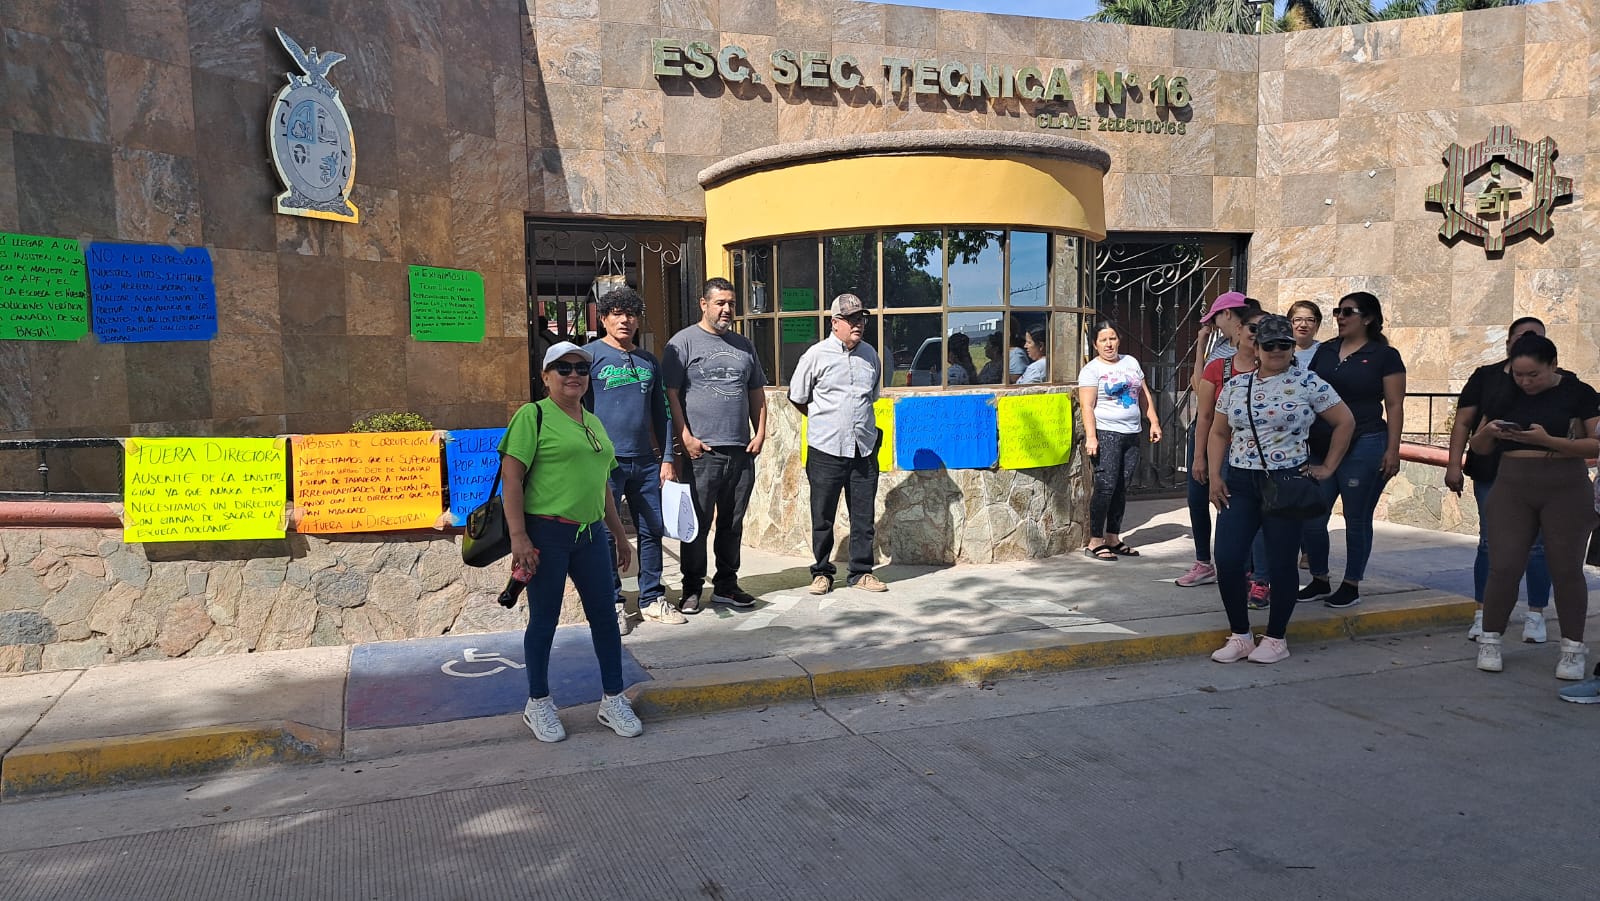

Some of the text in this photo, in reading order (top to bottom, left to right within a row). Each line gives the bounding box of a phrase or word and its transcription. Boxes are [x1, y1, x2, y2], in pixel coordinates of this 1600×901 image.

[652, 38, 761, 83] ESC.
[770, 49, 873, 88] SEC.
[881, 56, 1073, 101] TECNICA
[1149, 74, 1190, 107] 16
[1037, 113, 1090, 131] CLAVE:
[1484, 145, 1514, 154] DGEST
[91, 248, 112, 264] NO
[350, 439, 360, 448] DE
[456, 436, 498, 453] FUER
[137, 442, 280, 464] FUERA DIRECTORA
[299, 456, 363, 466] NECESITAMOS
[452, 460, 474, 472] POR
[132, 472, 194, 484] AUSENTE
[202, 473, 214, 483] DE
[221, 472, 235, 482] LA
[165, 488, 178, 497] YA
[185, 488, 202, 497] QUE
[210, 487, 242, 495] NUNCA
[132, 500, 282, 513] NECESITAMOS UN DIRECTIVO
[223, 511, 255, 520] SACAR
[264, 510, 275, 518] LA
[138, 523, 232, 537] ESCUELA ADELANTE
[351, 520, 362, 529] LA
